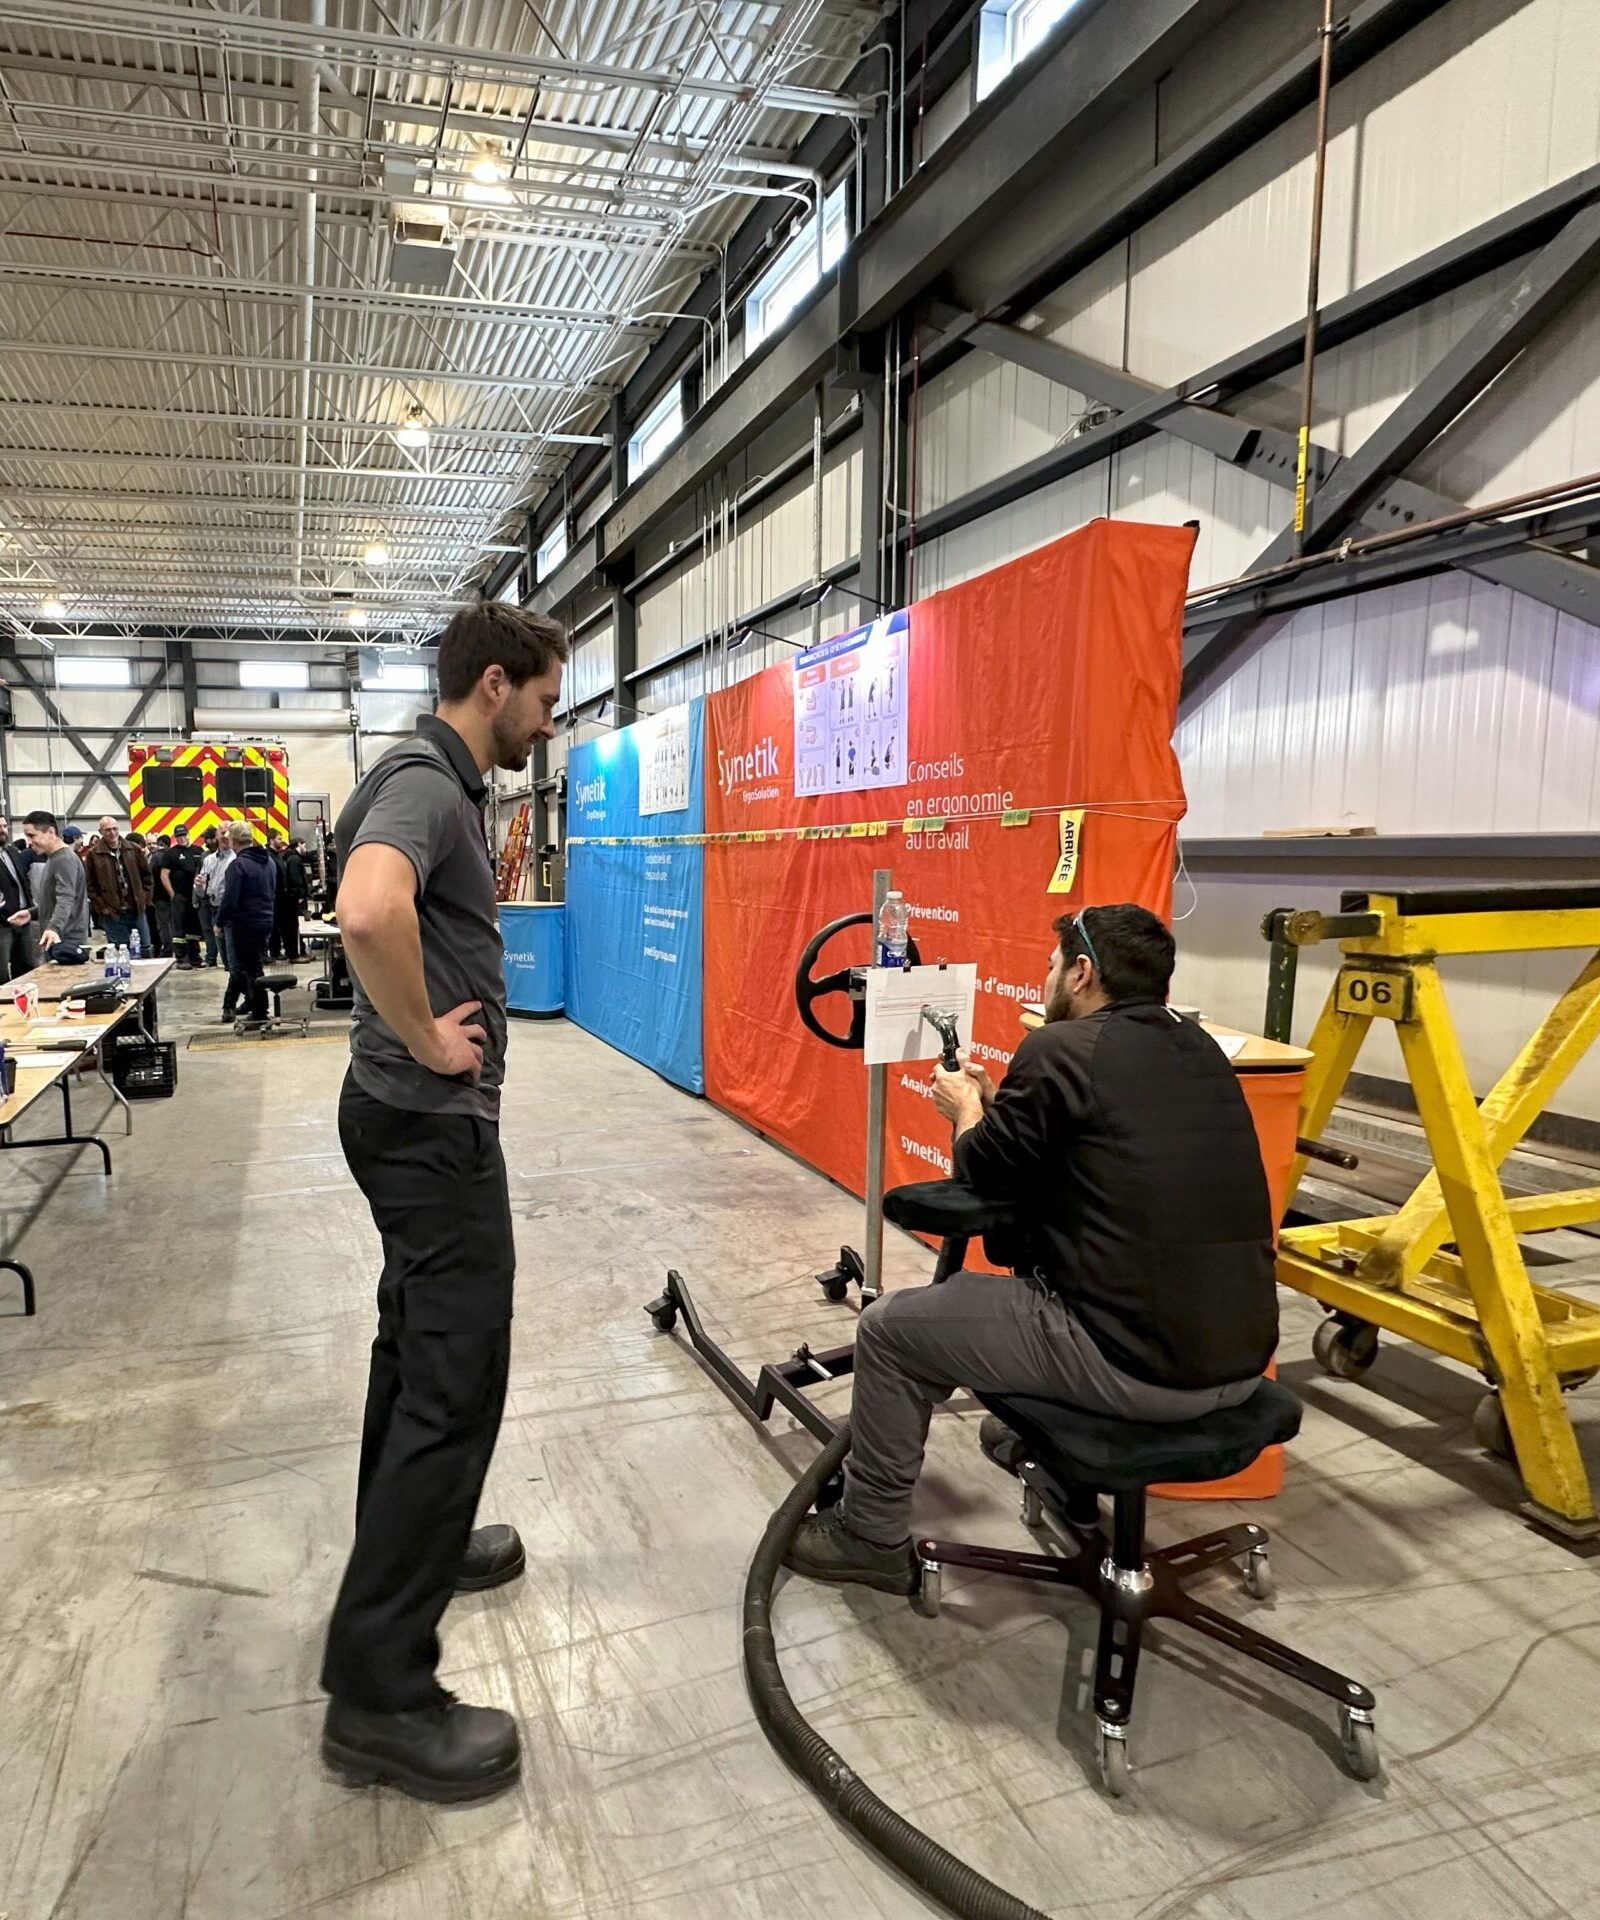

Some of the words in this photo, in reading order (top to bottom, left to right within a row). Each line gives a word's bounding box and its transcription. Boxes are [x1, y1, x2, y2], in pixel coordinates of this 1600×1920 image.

[717, 736, 779, 796] Synetik
[907, 752, 964, 783] Conseils
[575, 775, 606, 812] Synetik
[742, 786, 780, 805] ErgoSolution
[906, 798, 923, 817] en
[926, 786, 1013, 817] ergonomie
[905, 832, 922, 850] au
[926, 824, 970, 850] travail
[1057, 819, 1075, 882] ARRIVÉE
[904, 903, 959, 923] Prévention
[503, 950, 535, 963] Synetik
[984, 976, 1042, 1003] d'emploi
[1348, 979, 1392, 1004] 06
[971, 1041, 1014, 1065] ergono
[900, 1074, 934, 1098] Analys
[901, 1135, 952, 1176] synetikg
